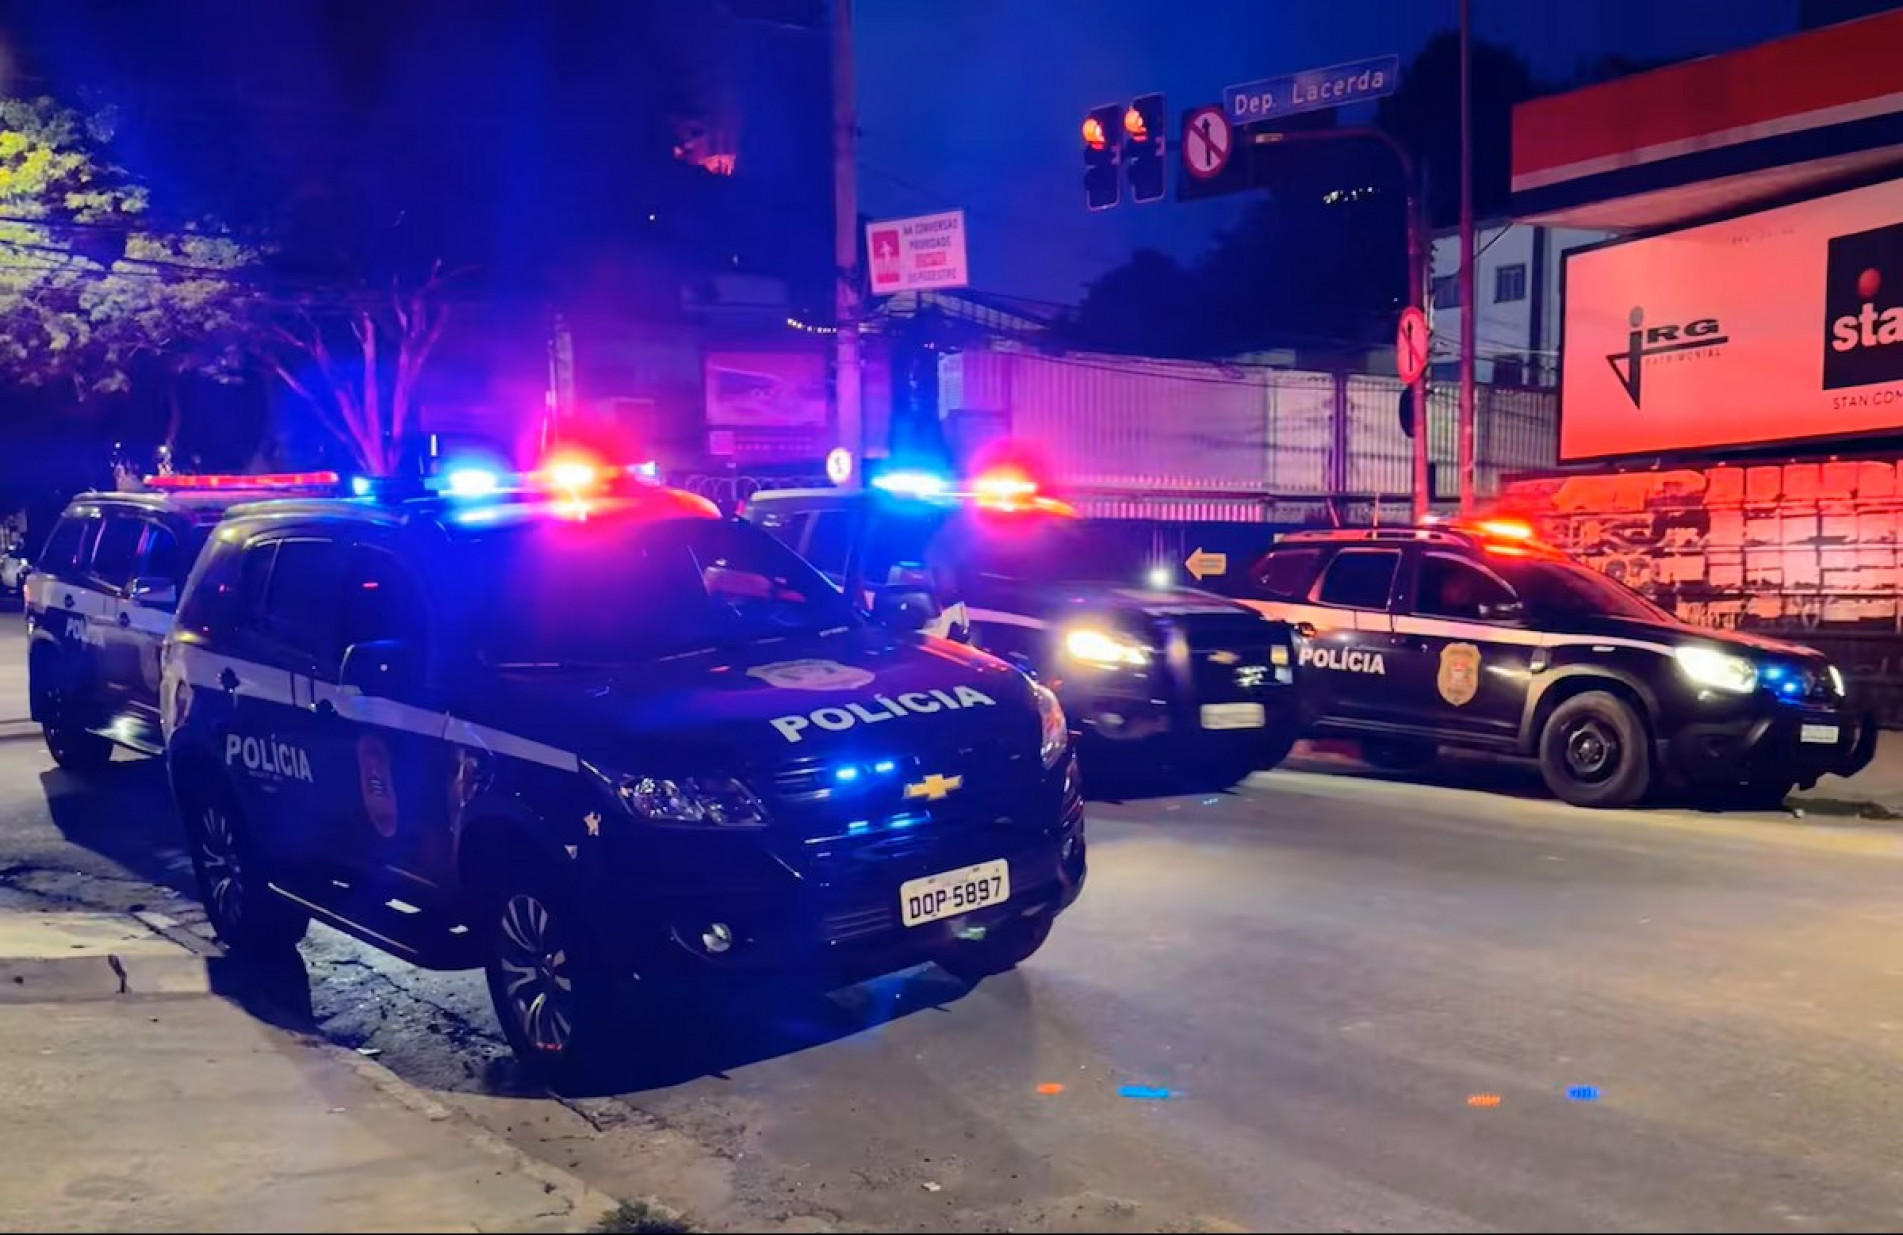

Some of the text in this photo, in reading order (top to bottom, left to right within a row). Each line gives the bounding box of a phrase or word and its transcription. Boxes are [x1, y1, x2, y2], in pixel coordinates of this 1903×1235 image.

[1234, 69, 1384, 115] Dep. Lacerda
[1299, 646, 1386, 675] POLÍCIA
[769, 685, 996, 743] POLÍCIA
[225, 733, 314, 783] POLÍCIA
